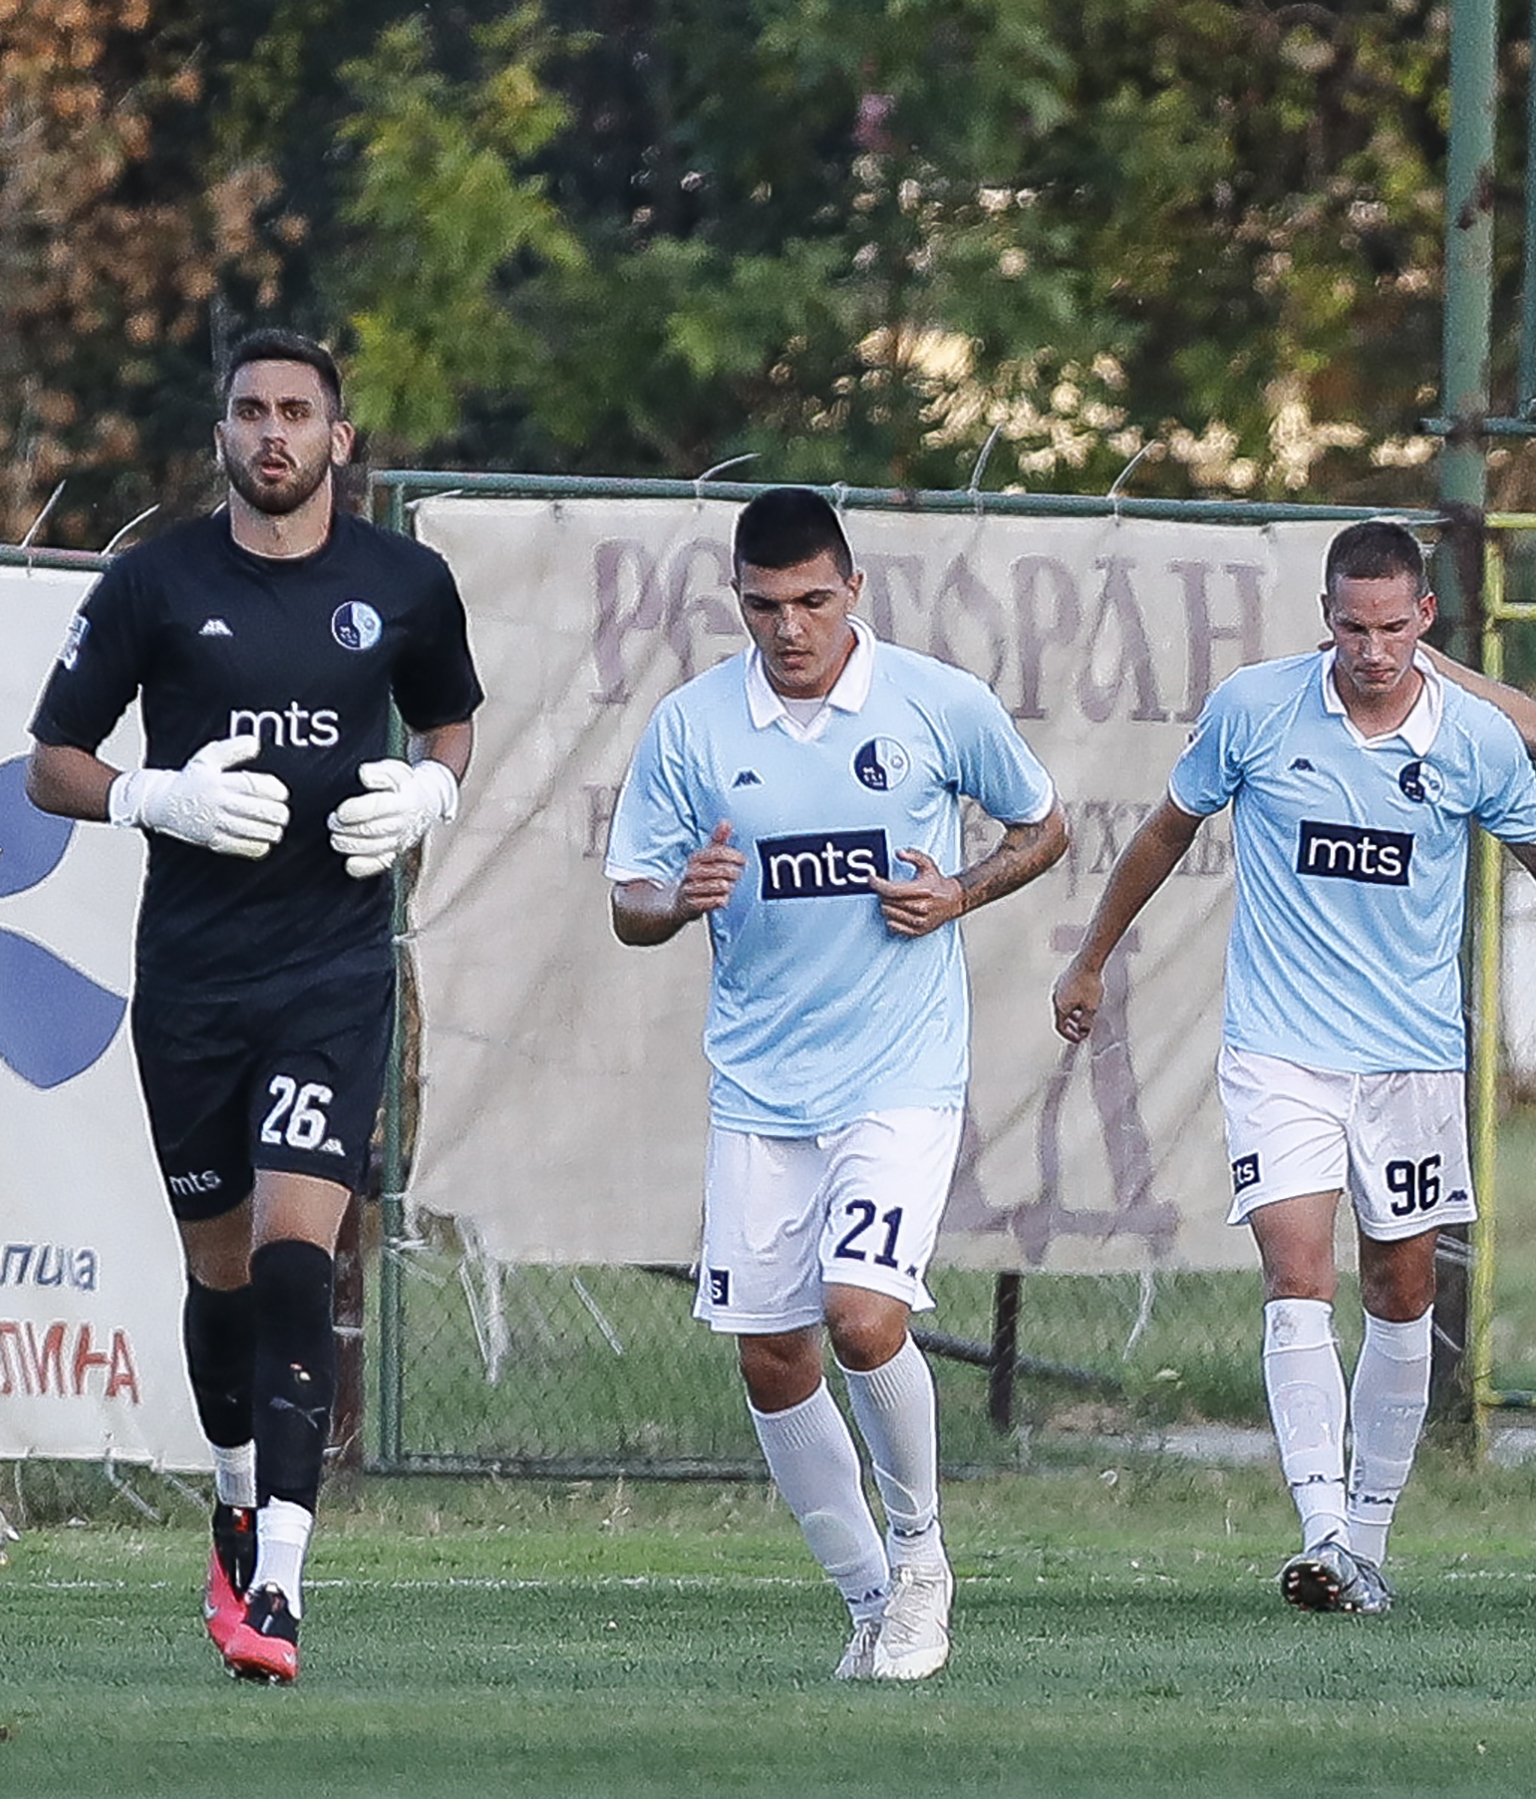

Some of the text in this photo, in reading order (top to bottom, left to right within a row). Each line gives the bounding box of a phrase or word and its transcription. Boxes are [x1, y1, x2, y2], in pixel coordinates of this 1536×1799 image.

[229, 701, 339, 747] mts
[769, 841, 877, 889] mts
[1308, 836, 1402, 876] mts
[261, 1075, 332, 1150] 26
[169, 1170, 221, 1195] mts
[1385, 1154, 1442, 1217] 96
[834, 1199, 904, 1269] 21
